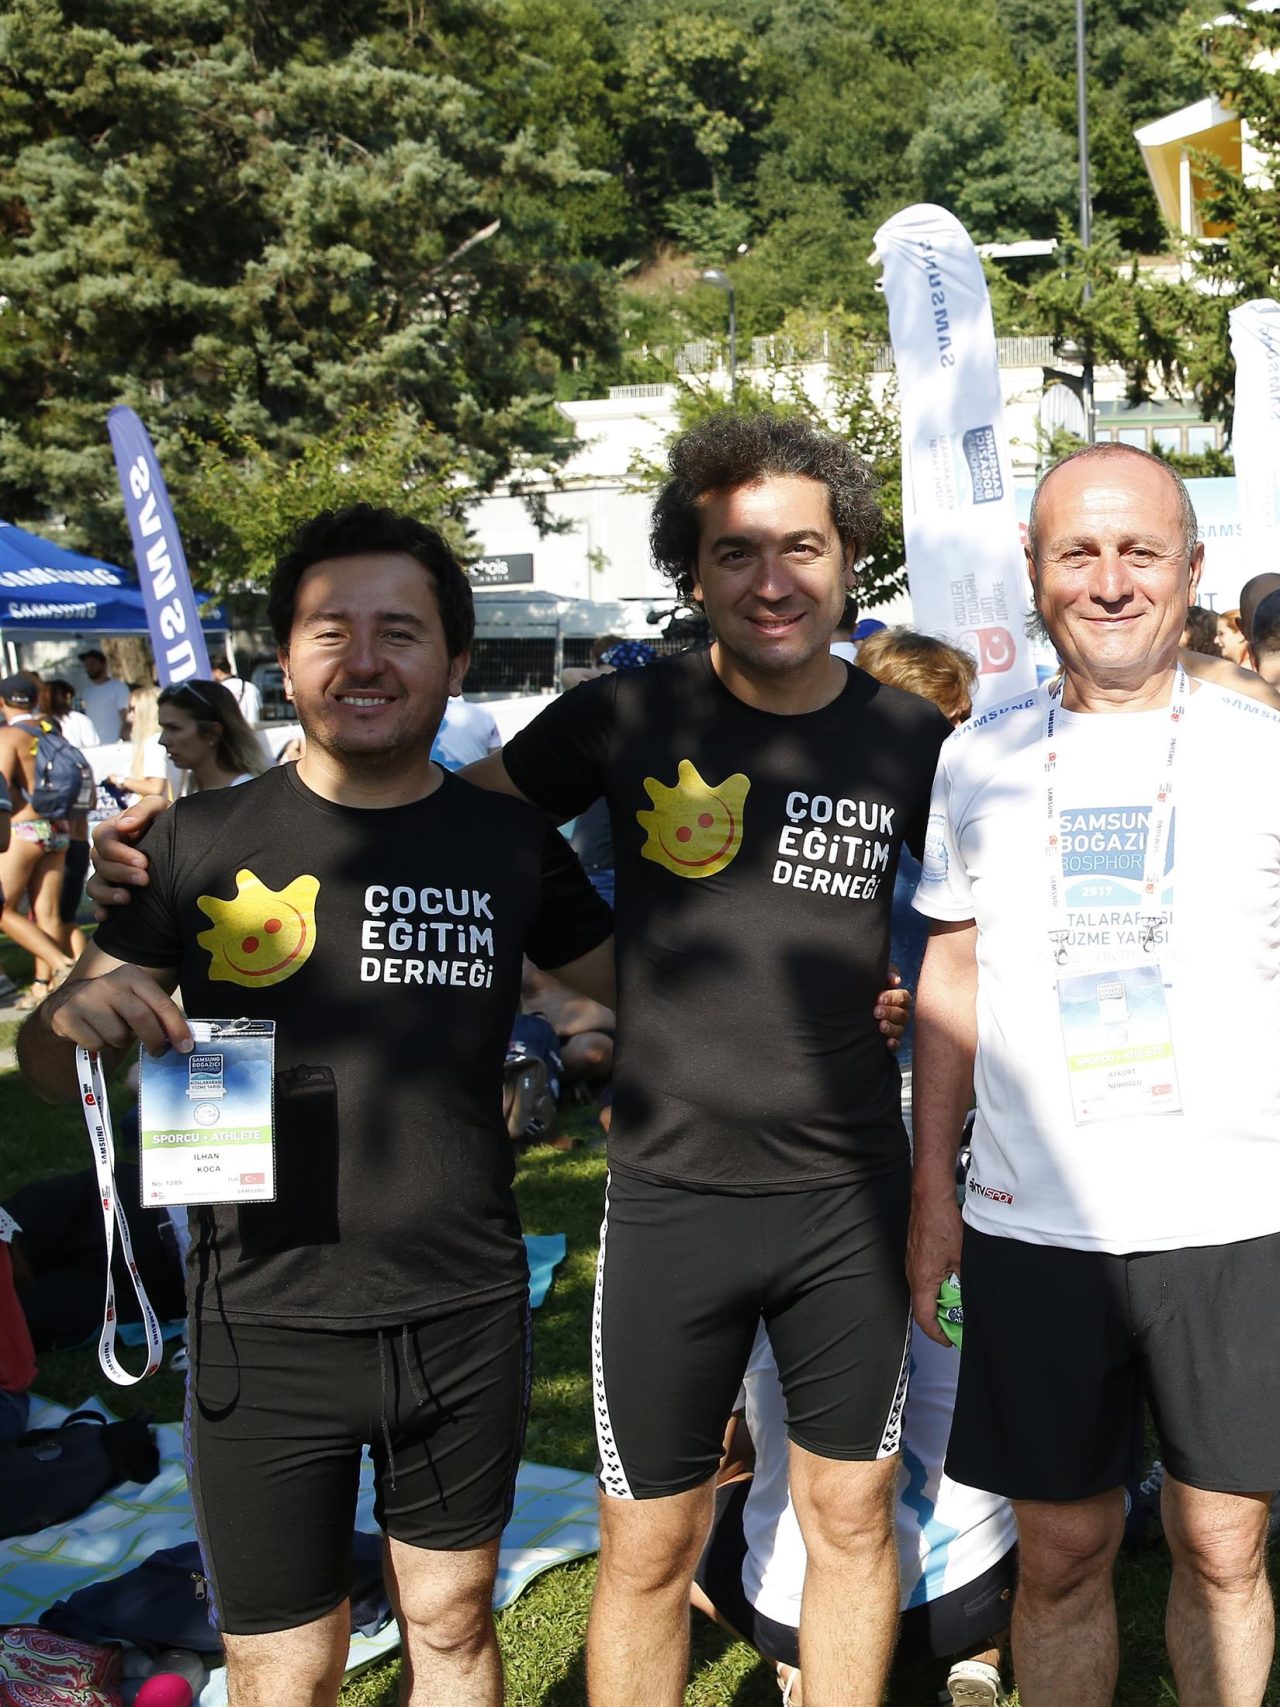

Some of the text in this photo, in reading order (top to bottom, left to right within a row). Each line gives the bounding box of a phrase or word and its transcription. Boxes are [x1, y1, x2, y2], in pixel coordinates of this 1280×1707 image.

[8, 602, 97, 619] SAMSUNG
[953, 698, 1034, 740] SAMSUNG
[1166, 737, 1177, 767] SAMSUNG
[786, 791, 895, 836] ÇOCUK
[1047, 787, 1055, 820] SAMSUNG
[364, 885, 494, 920] ÇOCUK
[1081, 885, 1113, 897] 2017
[1066, 929, 1111, 946] ÜZME
[96, 1126, 107, 1164] SAMSUNG
[151, 1131, 262, 1144] SPORCU ATHLETE
[197, 1165, 221, 1173] KOCA
[146, 1305, 158, 1345] SAMSUNG
